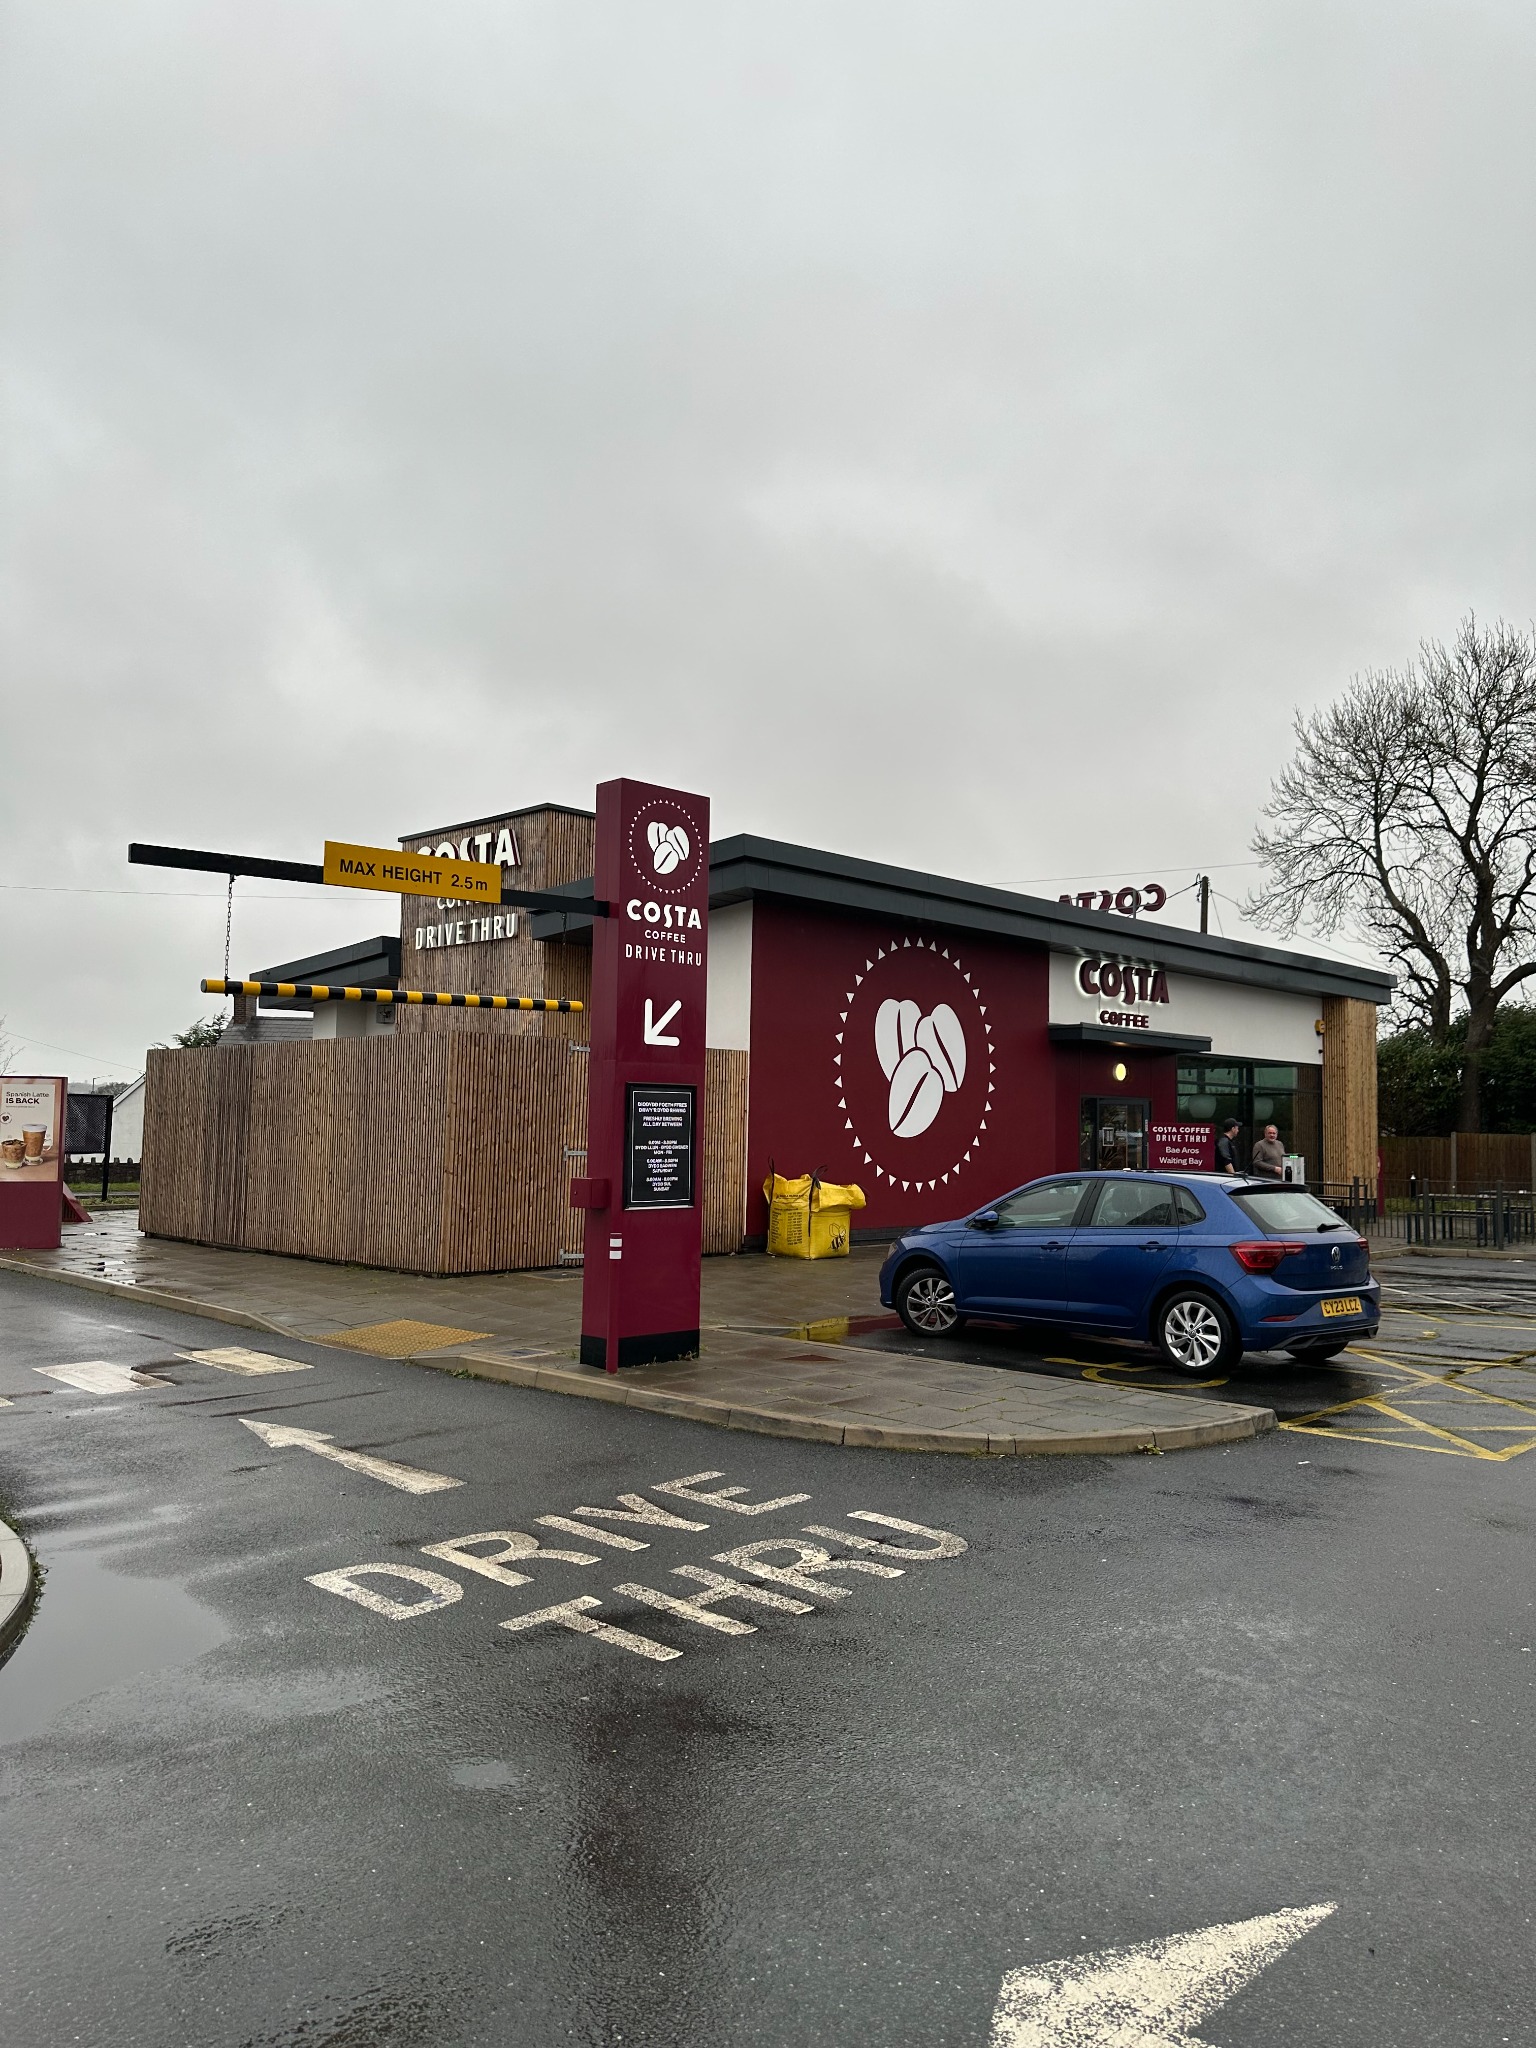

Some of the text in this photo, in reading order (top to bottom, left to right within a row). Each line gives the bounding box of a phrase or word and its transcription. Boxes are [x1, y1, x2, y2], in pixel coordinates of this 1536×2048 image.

[417, 829, 519, 866] STA
[340, 859, 376, 877] MAX
[382, 865, 442, 885] HEIGHT
[627, 899, 702, 929] COSTA
[416, 913, 518, 949] DRIVE THRU
[644, 930, 686, 943] COFFEE
[625, 944, 702, 967] DRIVE THRU
[1079, 959, 1170, 1006] COSTA
[1099, 1010, 1150, 1029] COFFEE
[1156, 1134, 1207, 1143] DRIVE THRU
[1165, 1146, 1200, 1154] Bae Aros
[1159, 1156, 1203, 1166] Waiting Bay
[1323, 1298, 1359, 1314] CY23 LCZ
[304, 1471, 812, 1621] DRIVE
[498, 1510, 969, 1661] THRU
